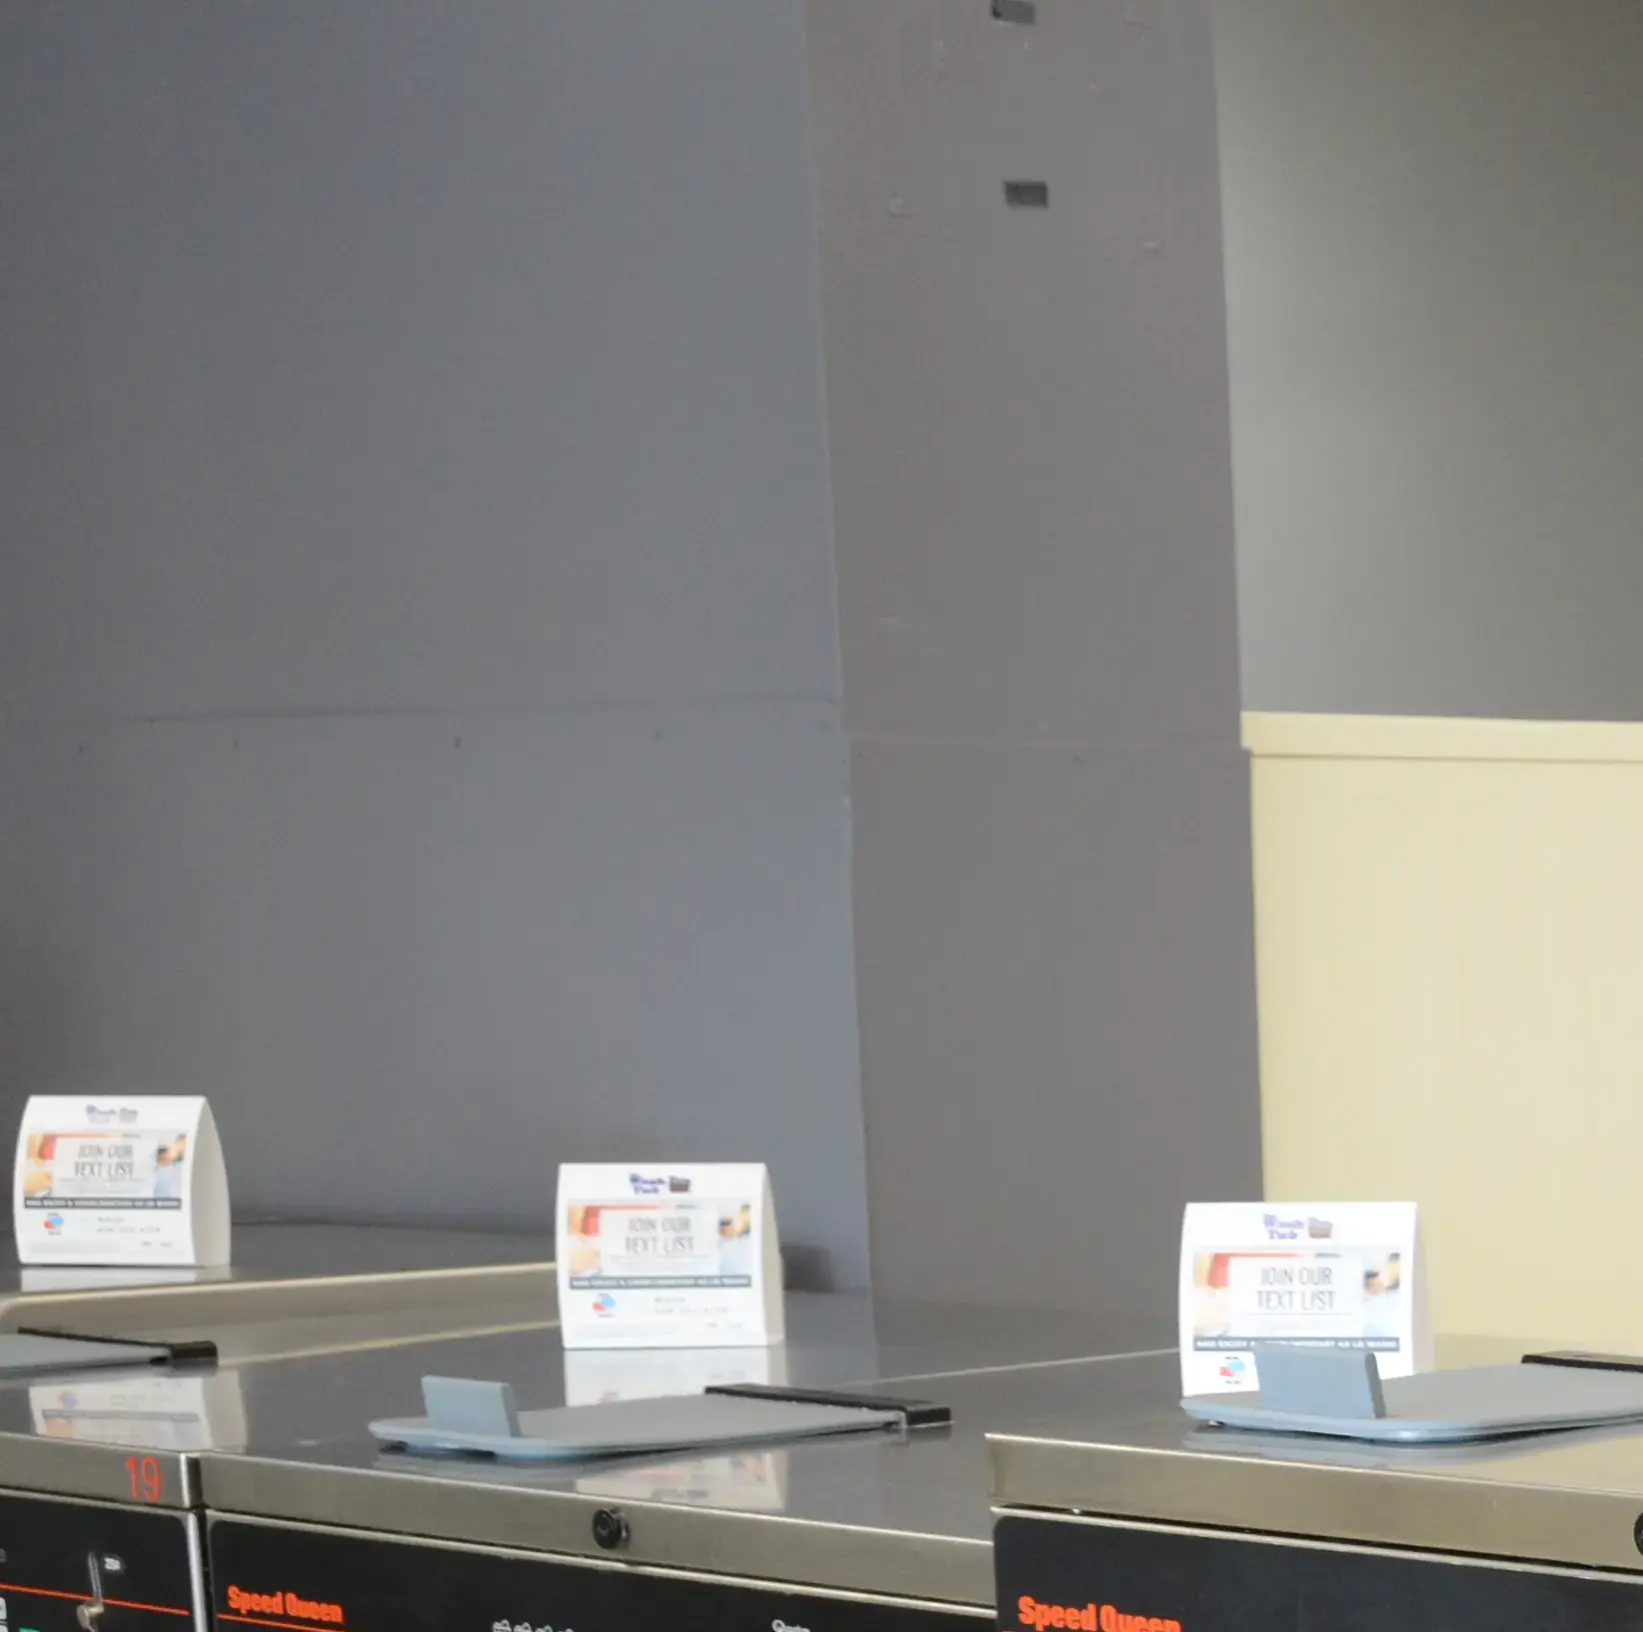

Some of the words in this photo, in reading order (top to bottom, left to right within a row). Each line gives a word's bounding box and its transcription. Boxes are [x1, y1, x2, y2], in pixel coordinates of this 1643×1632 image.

[1261, 1266, 1293, 1286] JOIN
[1299, 1266, 1332, 1286] OUR
[1256, 1290, 1295, 1311] TEXT
[1301, 1290, 1337, 1311] LIST
[124, 1454, 162, 1503] 19
[228, 1584, 283, 1615] Speed
[285, 1592, 344, 1625] Queen
[1018, 1595, 1097, 1632] Speed
